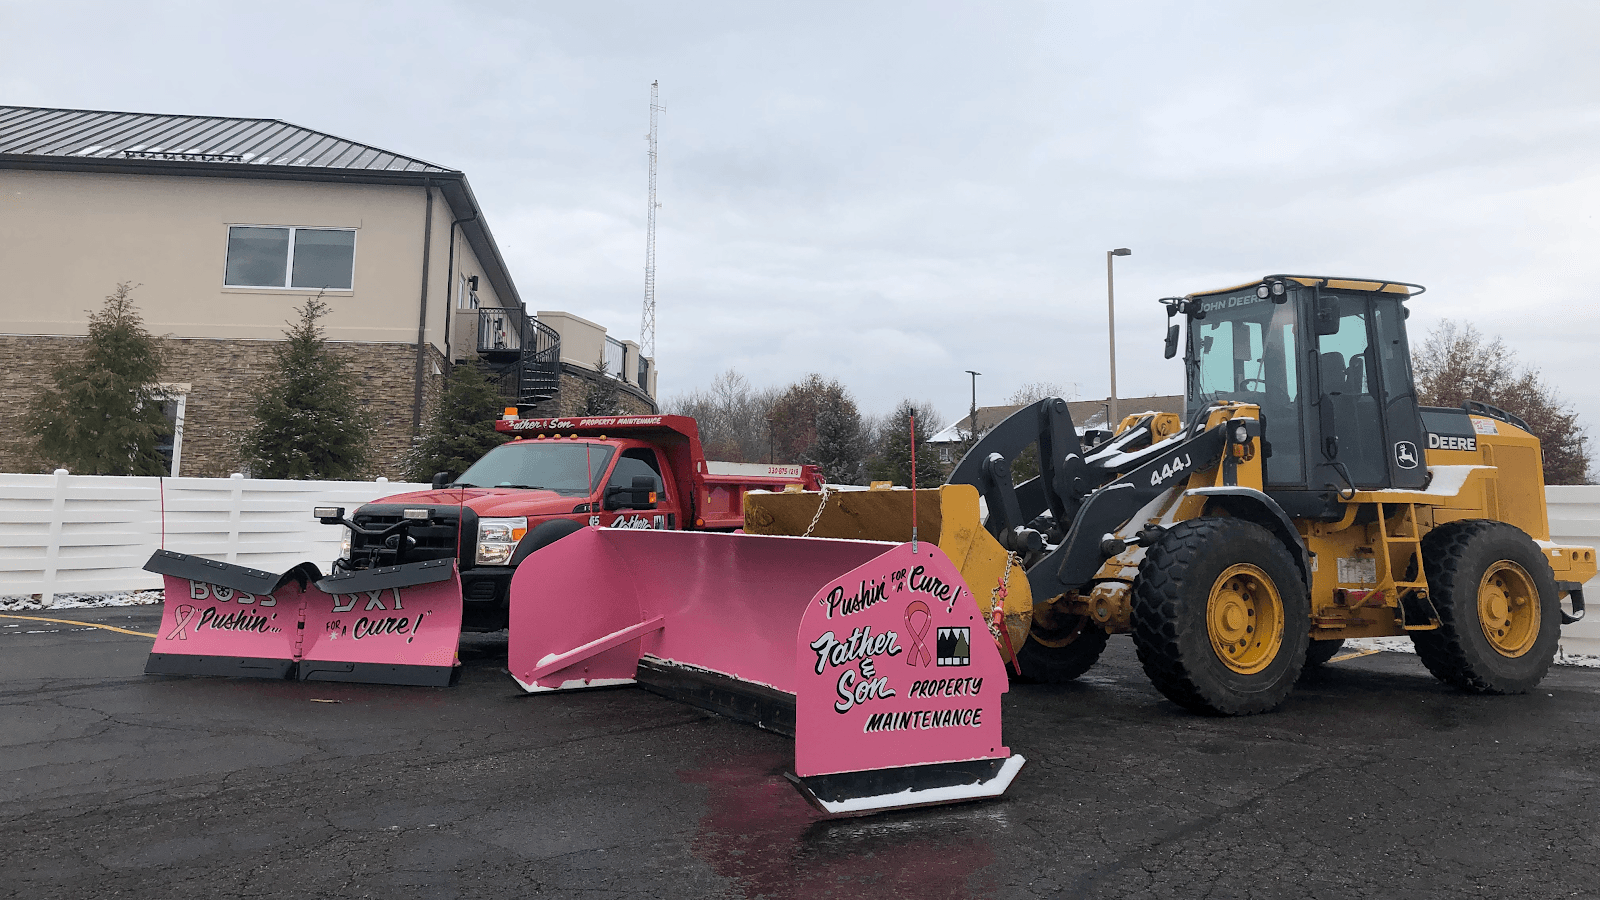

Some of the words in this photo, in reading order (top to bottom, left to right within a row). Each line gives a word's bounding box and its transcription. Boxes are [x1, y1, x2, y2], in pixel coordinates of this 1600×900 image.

[1197, 301, 1225, 313] JOHN
[549, 418, 575, 429] Son
[580, 418, 616, 426] PROPERTY
[617, 417, 662, 425] MAINTENANCE
[1428, 432, 1477, 451] DEERE
[1150, 453, 1192, 486] 444J
[891, 568, 907, 583] FOR
[896, 581, 904, 593] A
[326, 619, 341, 632] FOR
[341, 625, 347, 636] A
[810, 626, 902, 675] Father
[859, 658, 876, 678] &
[834, 669, 896, 714] Son
[908, 677, 983, 699] PROPERTY
[863, 708, 983, 733] MAINTENANCE
